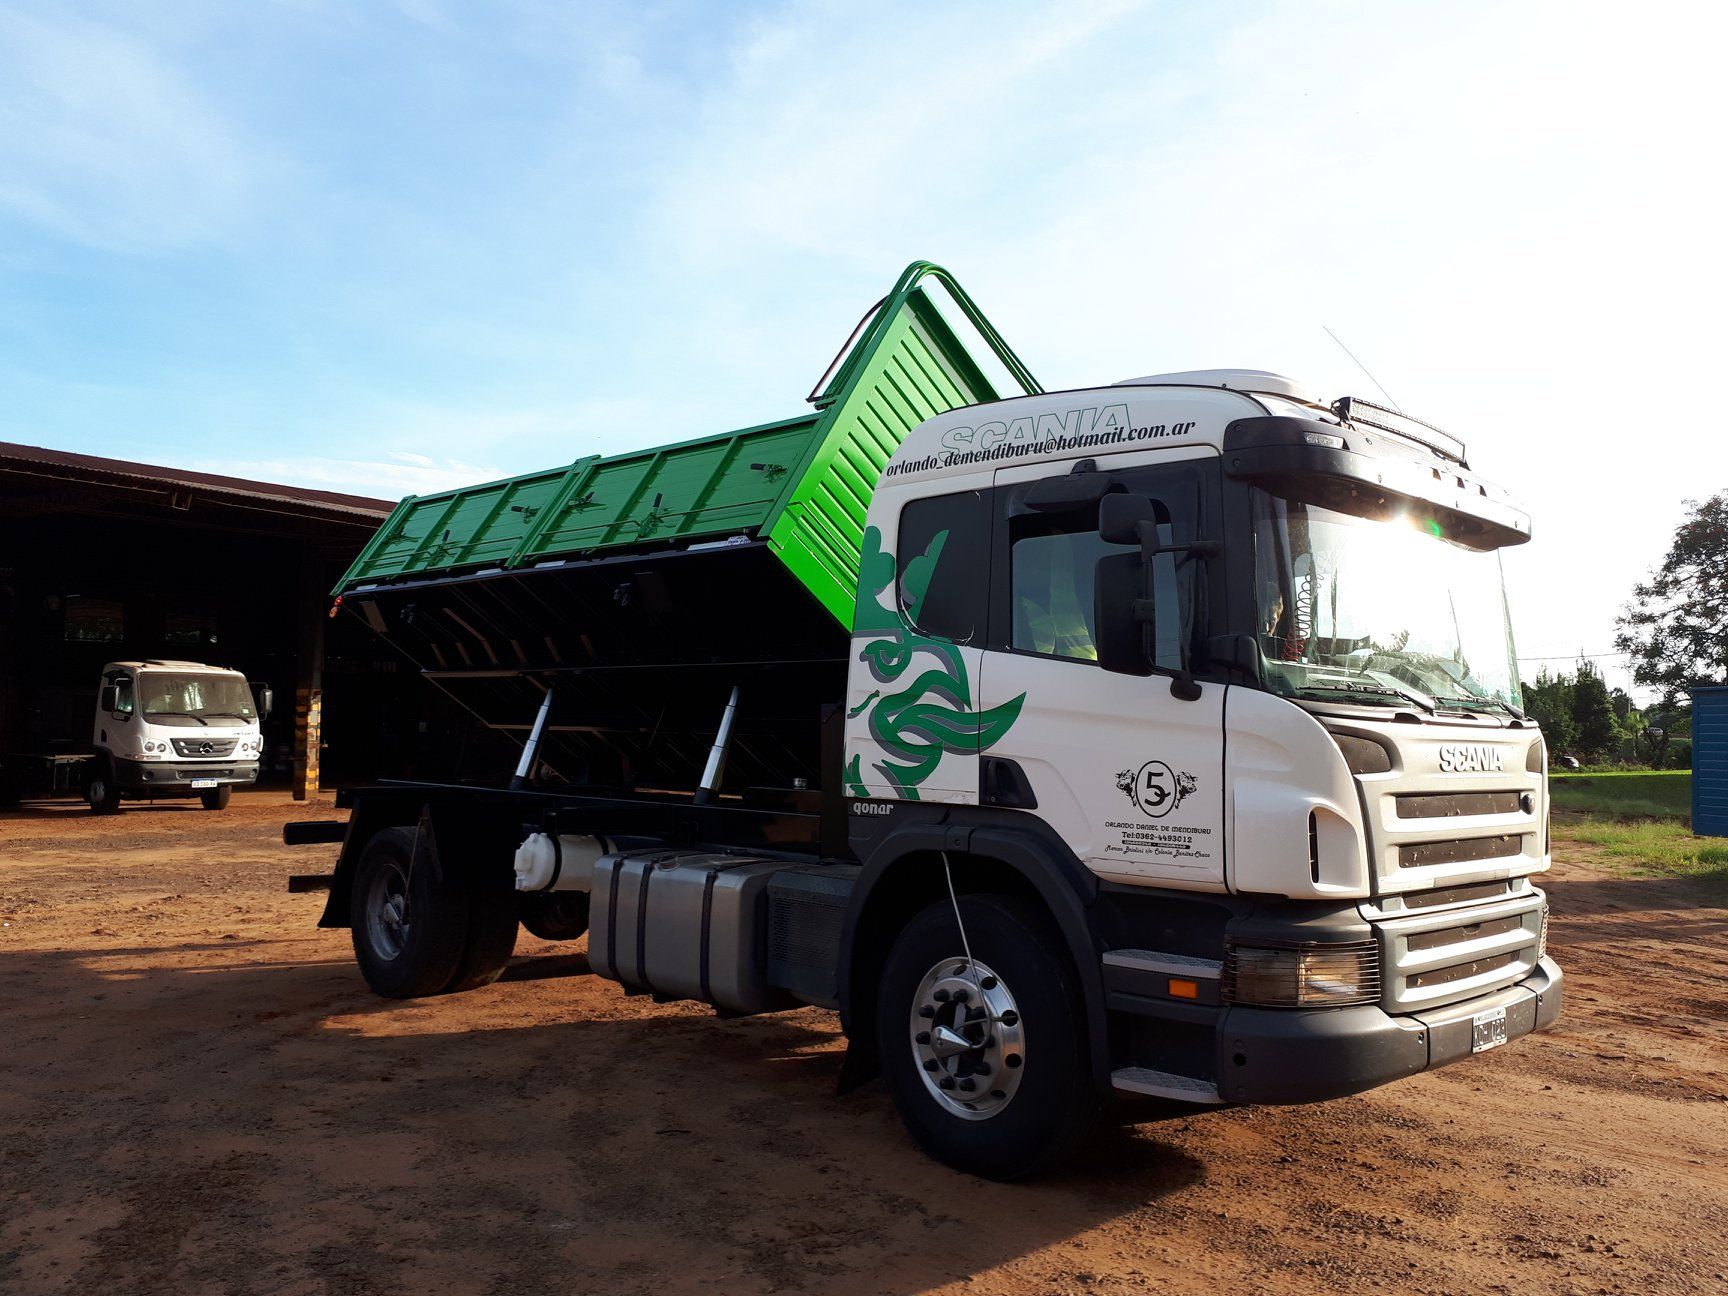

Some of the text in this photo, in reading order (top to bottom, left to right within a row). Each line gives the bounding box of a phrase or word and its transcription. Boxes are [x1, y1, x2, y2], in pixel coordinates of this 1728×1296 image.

[886, 420, 1196, 477] orlando_demendiburu@hotmail.com.ar
[939, 403, 1131, 463] SCANIA
[1439, 746, 1503, 772] SCANIA
[1104, 821, 1135, 829] ORLANDO
[1135, 823, 1159, 831] DANIEL
[1171, 826, 1212, 835] MENDIBURU
